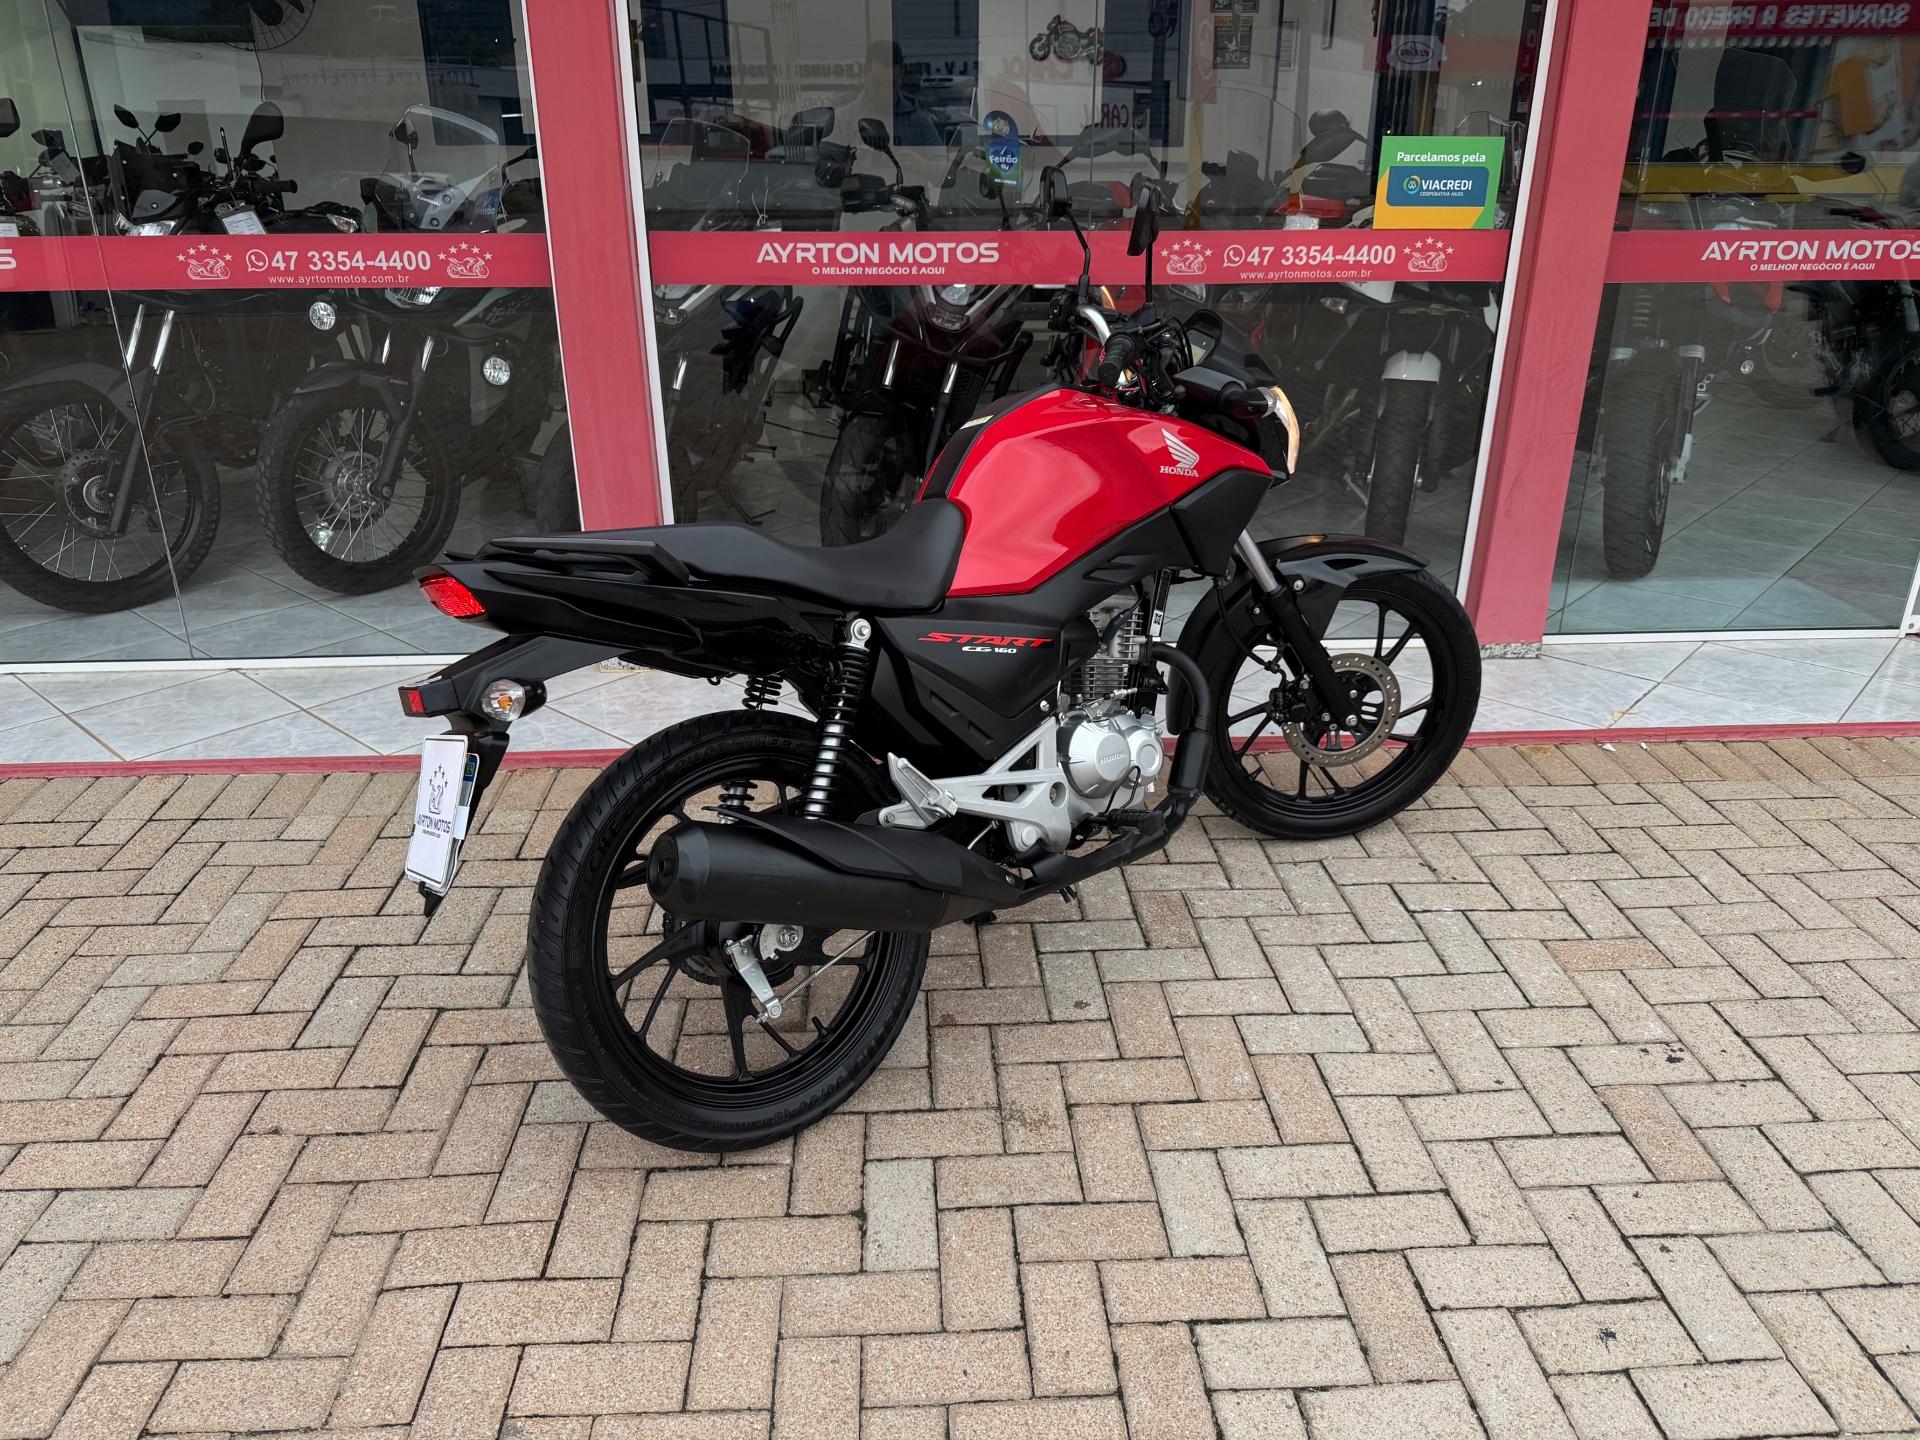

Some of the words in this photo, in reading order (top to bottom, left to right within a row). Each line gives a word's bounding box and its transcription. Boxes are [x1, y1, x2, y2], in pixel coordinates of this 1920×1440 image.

[1396, 151, 1460, 163] Parcelamos
[1462, 152, 1486, 164] pela
[1421, 179, 1473, 190] VIACREDI
[757, 242, 880, 264] AYRTON
[889, 242, 1000, 264] MOTOS
[1247, 246, 1275, 266] 47
[1281, 245, 1396, 265] 3354-4400
[1701, 240, 1820, 261] AYRTON
[1825, 239, 1920, 260] MOTOS
[271, 250, 298, 271] 47
[307, 250, 431, 271] 3354-4400
[1750, 263, 1758, 271] O
[1759, 262, 1798, 271] MELHOR
[1799, 261, 1842, 271] NEGÓCIO
[1843, 261, 1850, 270] É
[1850, 262, 1876, 270] AQUI
[812, 267, 822, 275] O
[824, 267, 863, 275] MELHOR
[865, 265, 908, 275] NEGÓCIO
[911, 264, 919, 275] É
[921, 267, 945, 275] AQUI
[1240, 269, 1373, 280] www.ayrtonmotos.com.br
[268, 273, 410, 285] www.ayrtonmotos.com.br
[1159, 465, 1200, 478] HONDA
[918, 632, 1054, 648] START
[961, 645, 993, 653] CG
[994, 646, 1017, 654] 160
